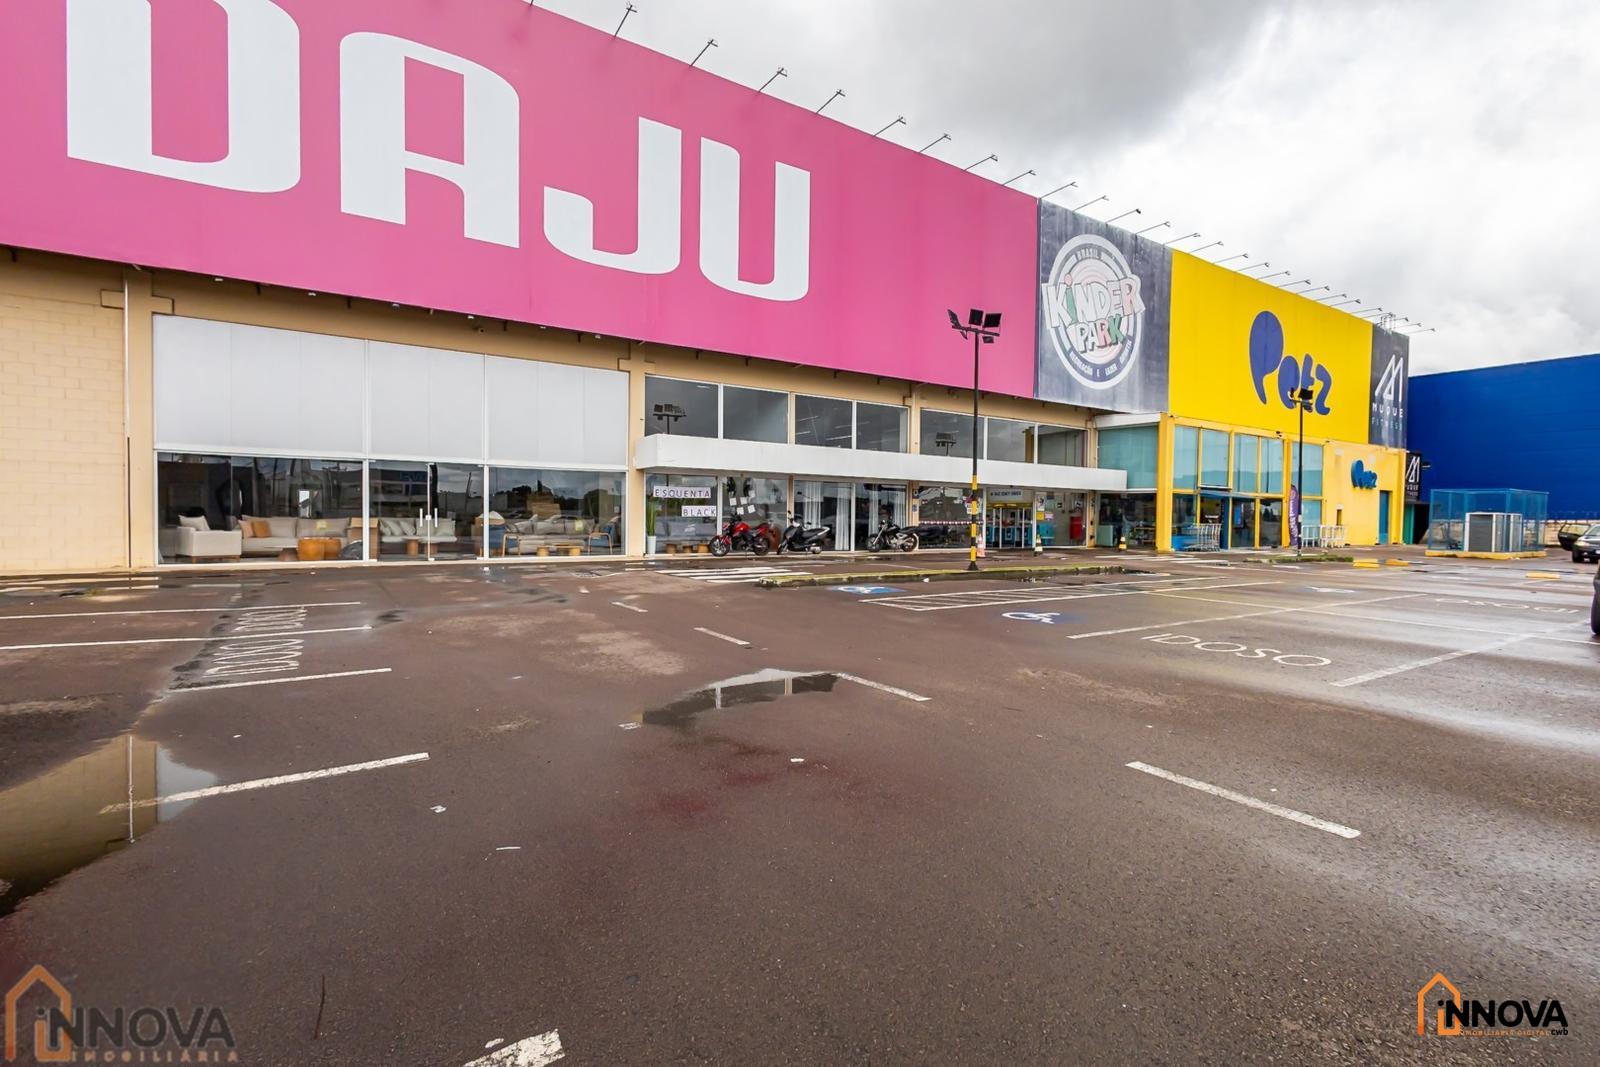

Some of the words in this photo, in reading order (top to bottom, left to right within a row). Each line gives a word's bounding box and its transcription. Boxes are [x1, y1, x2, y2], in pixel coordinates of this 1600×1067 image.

[66, 0, 811, 302] DAJU
[1073, 314, 1126, 354] PARK
[1372, 402, 1404, 418] MUQUE
[654, 487, 711, 498] ESQUENTA
[682, 507, 717, 517] BLACK
[1140, 632, 1332, 666] IDOSO
